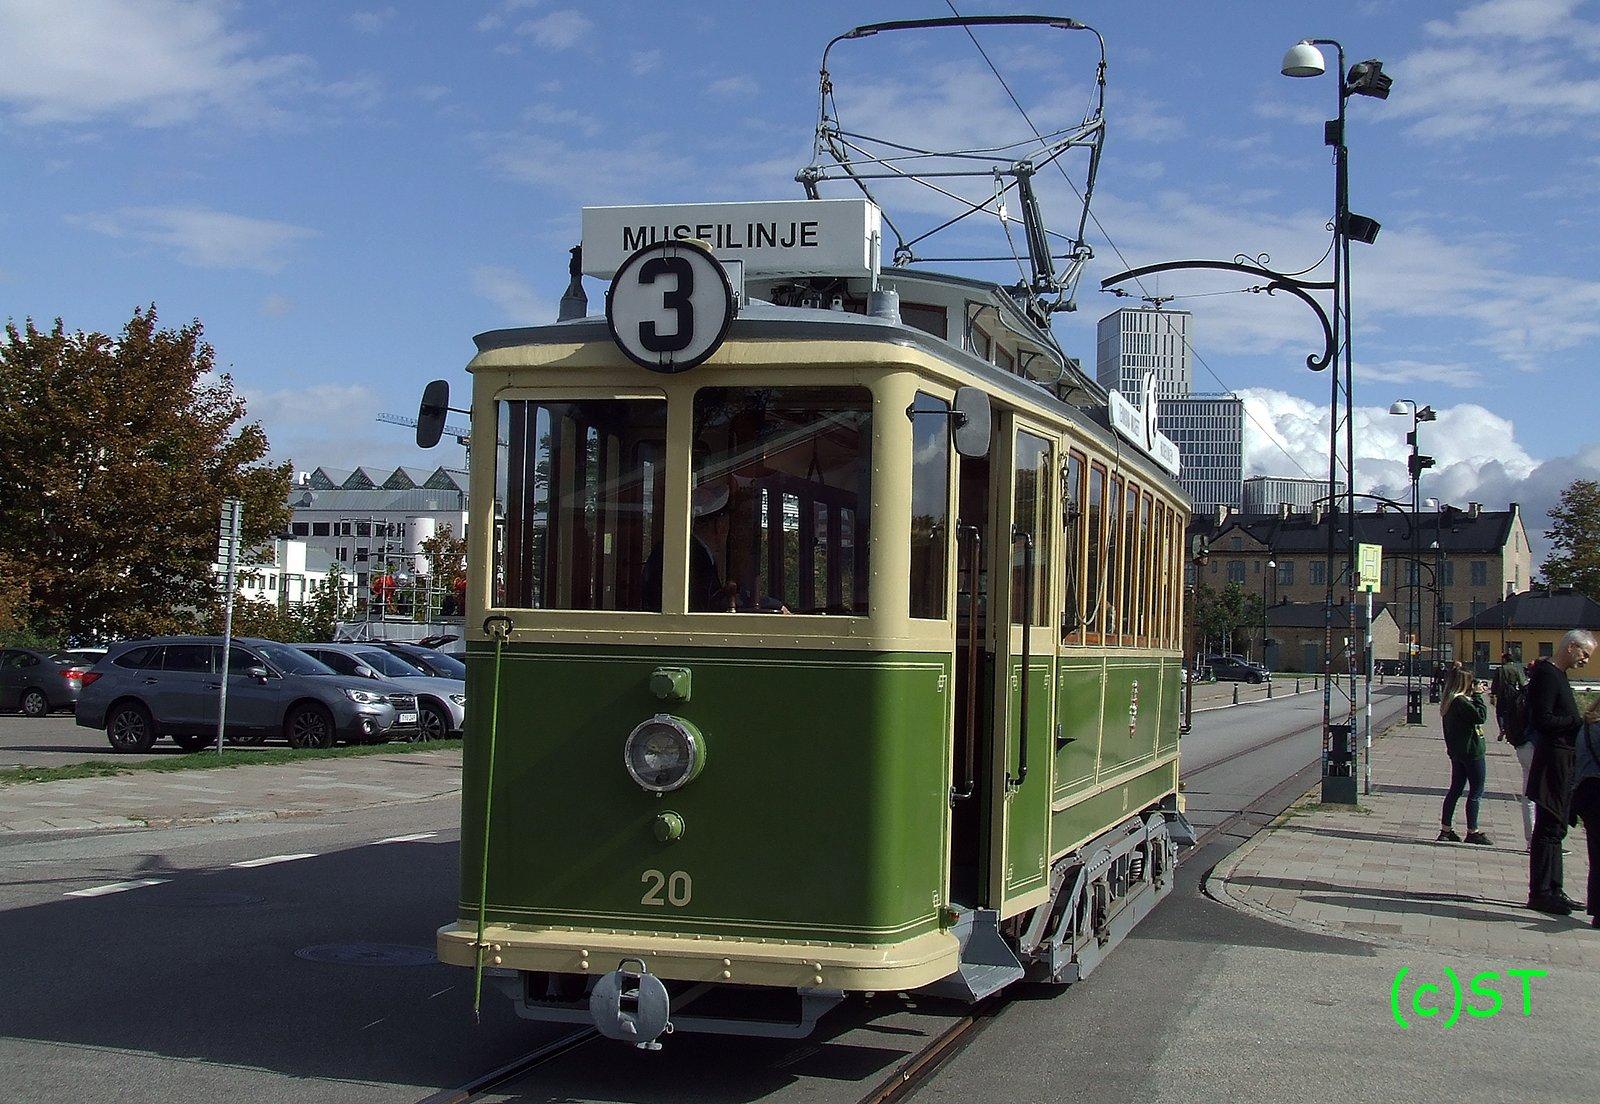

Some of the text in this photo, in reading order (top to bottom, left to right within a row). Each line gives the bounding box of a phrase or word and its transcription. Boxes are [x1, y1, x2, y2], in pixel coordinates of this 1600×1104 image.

[623, 221, 819, 251] MUSEILINJE
[638, 257, 694, 352] 3
[641, 869, 692, 907] 20
